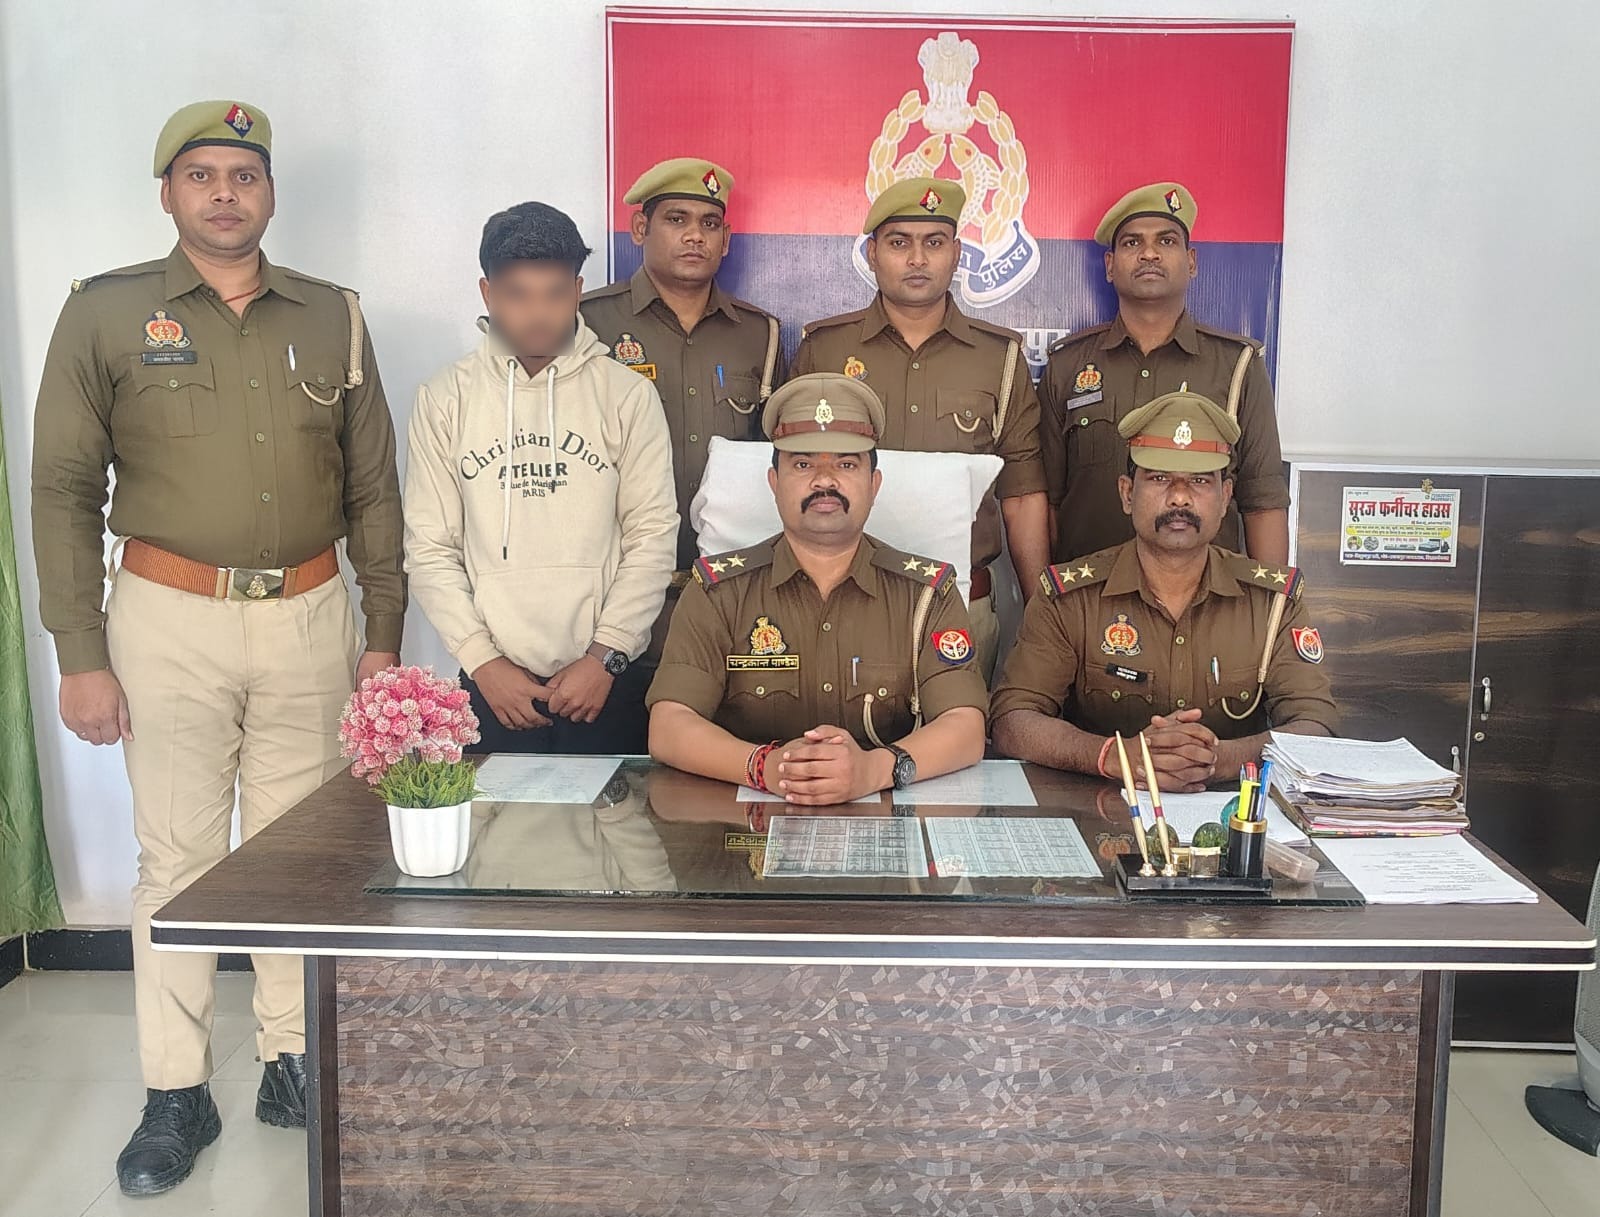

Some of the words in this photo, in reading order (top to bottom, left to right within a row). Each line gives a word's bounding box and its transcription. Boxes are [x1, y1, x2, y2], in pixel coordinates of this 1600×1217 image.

[980, 242, 1028, 290] पुलिस
[557, 429, 609, 474] Dior
[498, 462, 568, 479] ATELIER
[522, 488, 546, 498] PARIS
[1348, 500, 1377, 522] सूरज
[1379, 496, 1420, 518] फर्नीचर
[1422, 502, 1452, 518] हाउस
